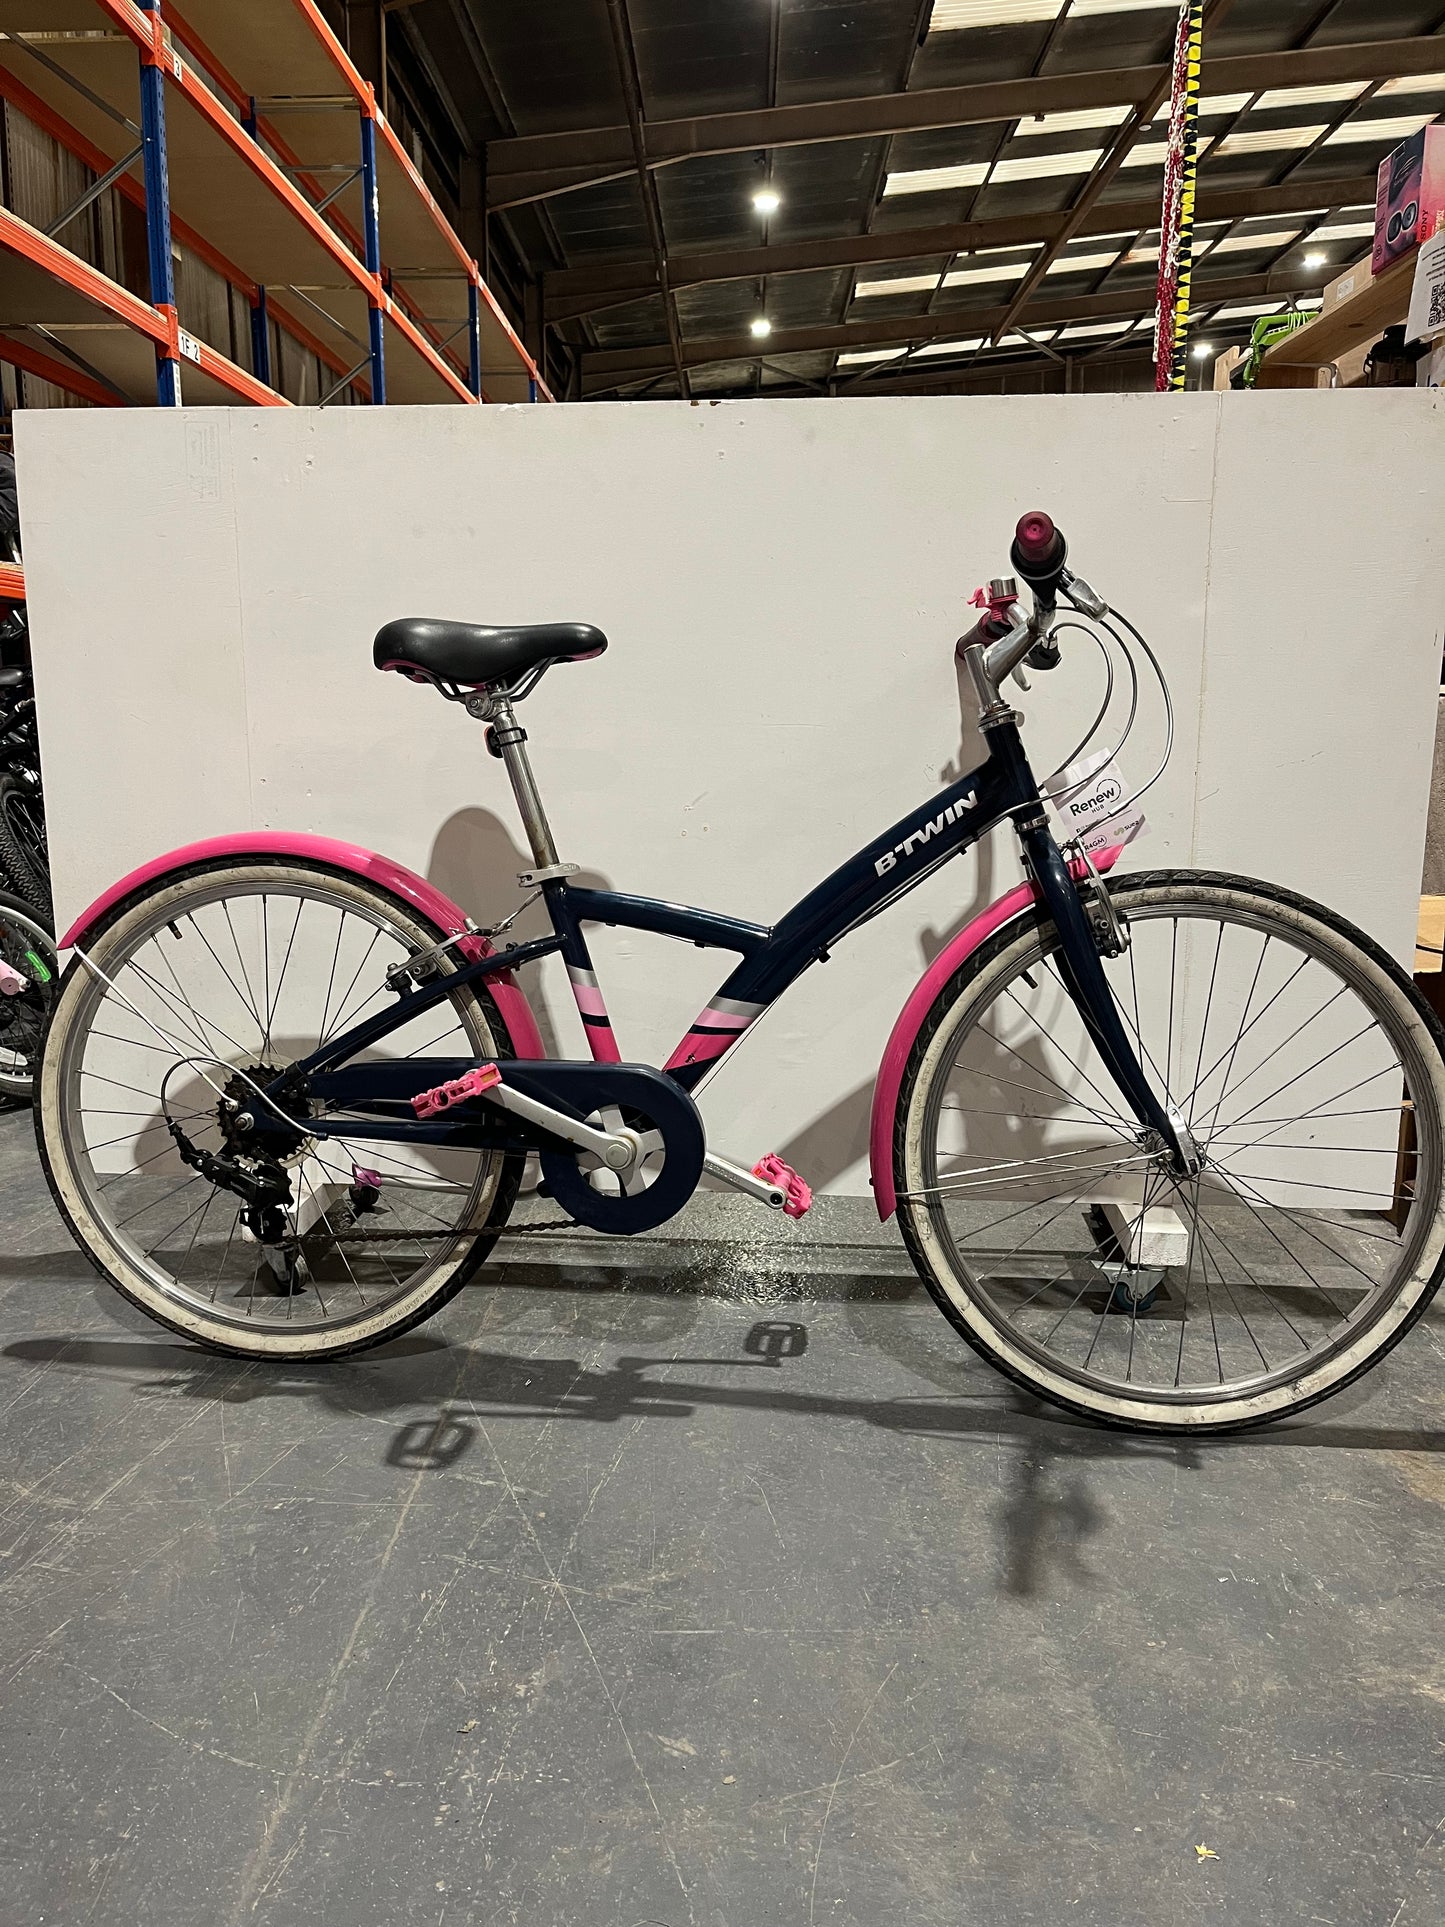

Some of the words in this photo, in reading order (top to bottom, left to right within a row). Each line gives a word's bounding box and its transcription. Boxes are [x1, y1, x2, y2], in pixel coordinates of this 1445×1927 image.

[1421, 209, 1429, 240] SONY
[1070, 787, 1115, 816] Renew
[1091, 804, 1105, 814] HUB
